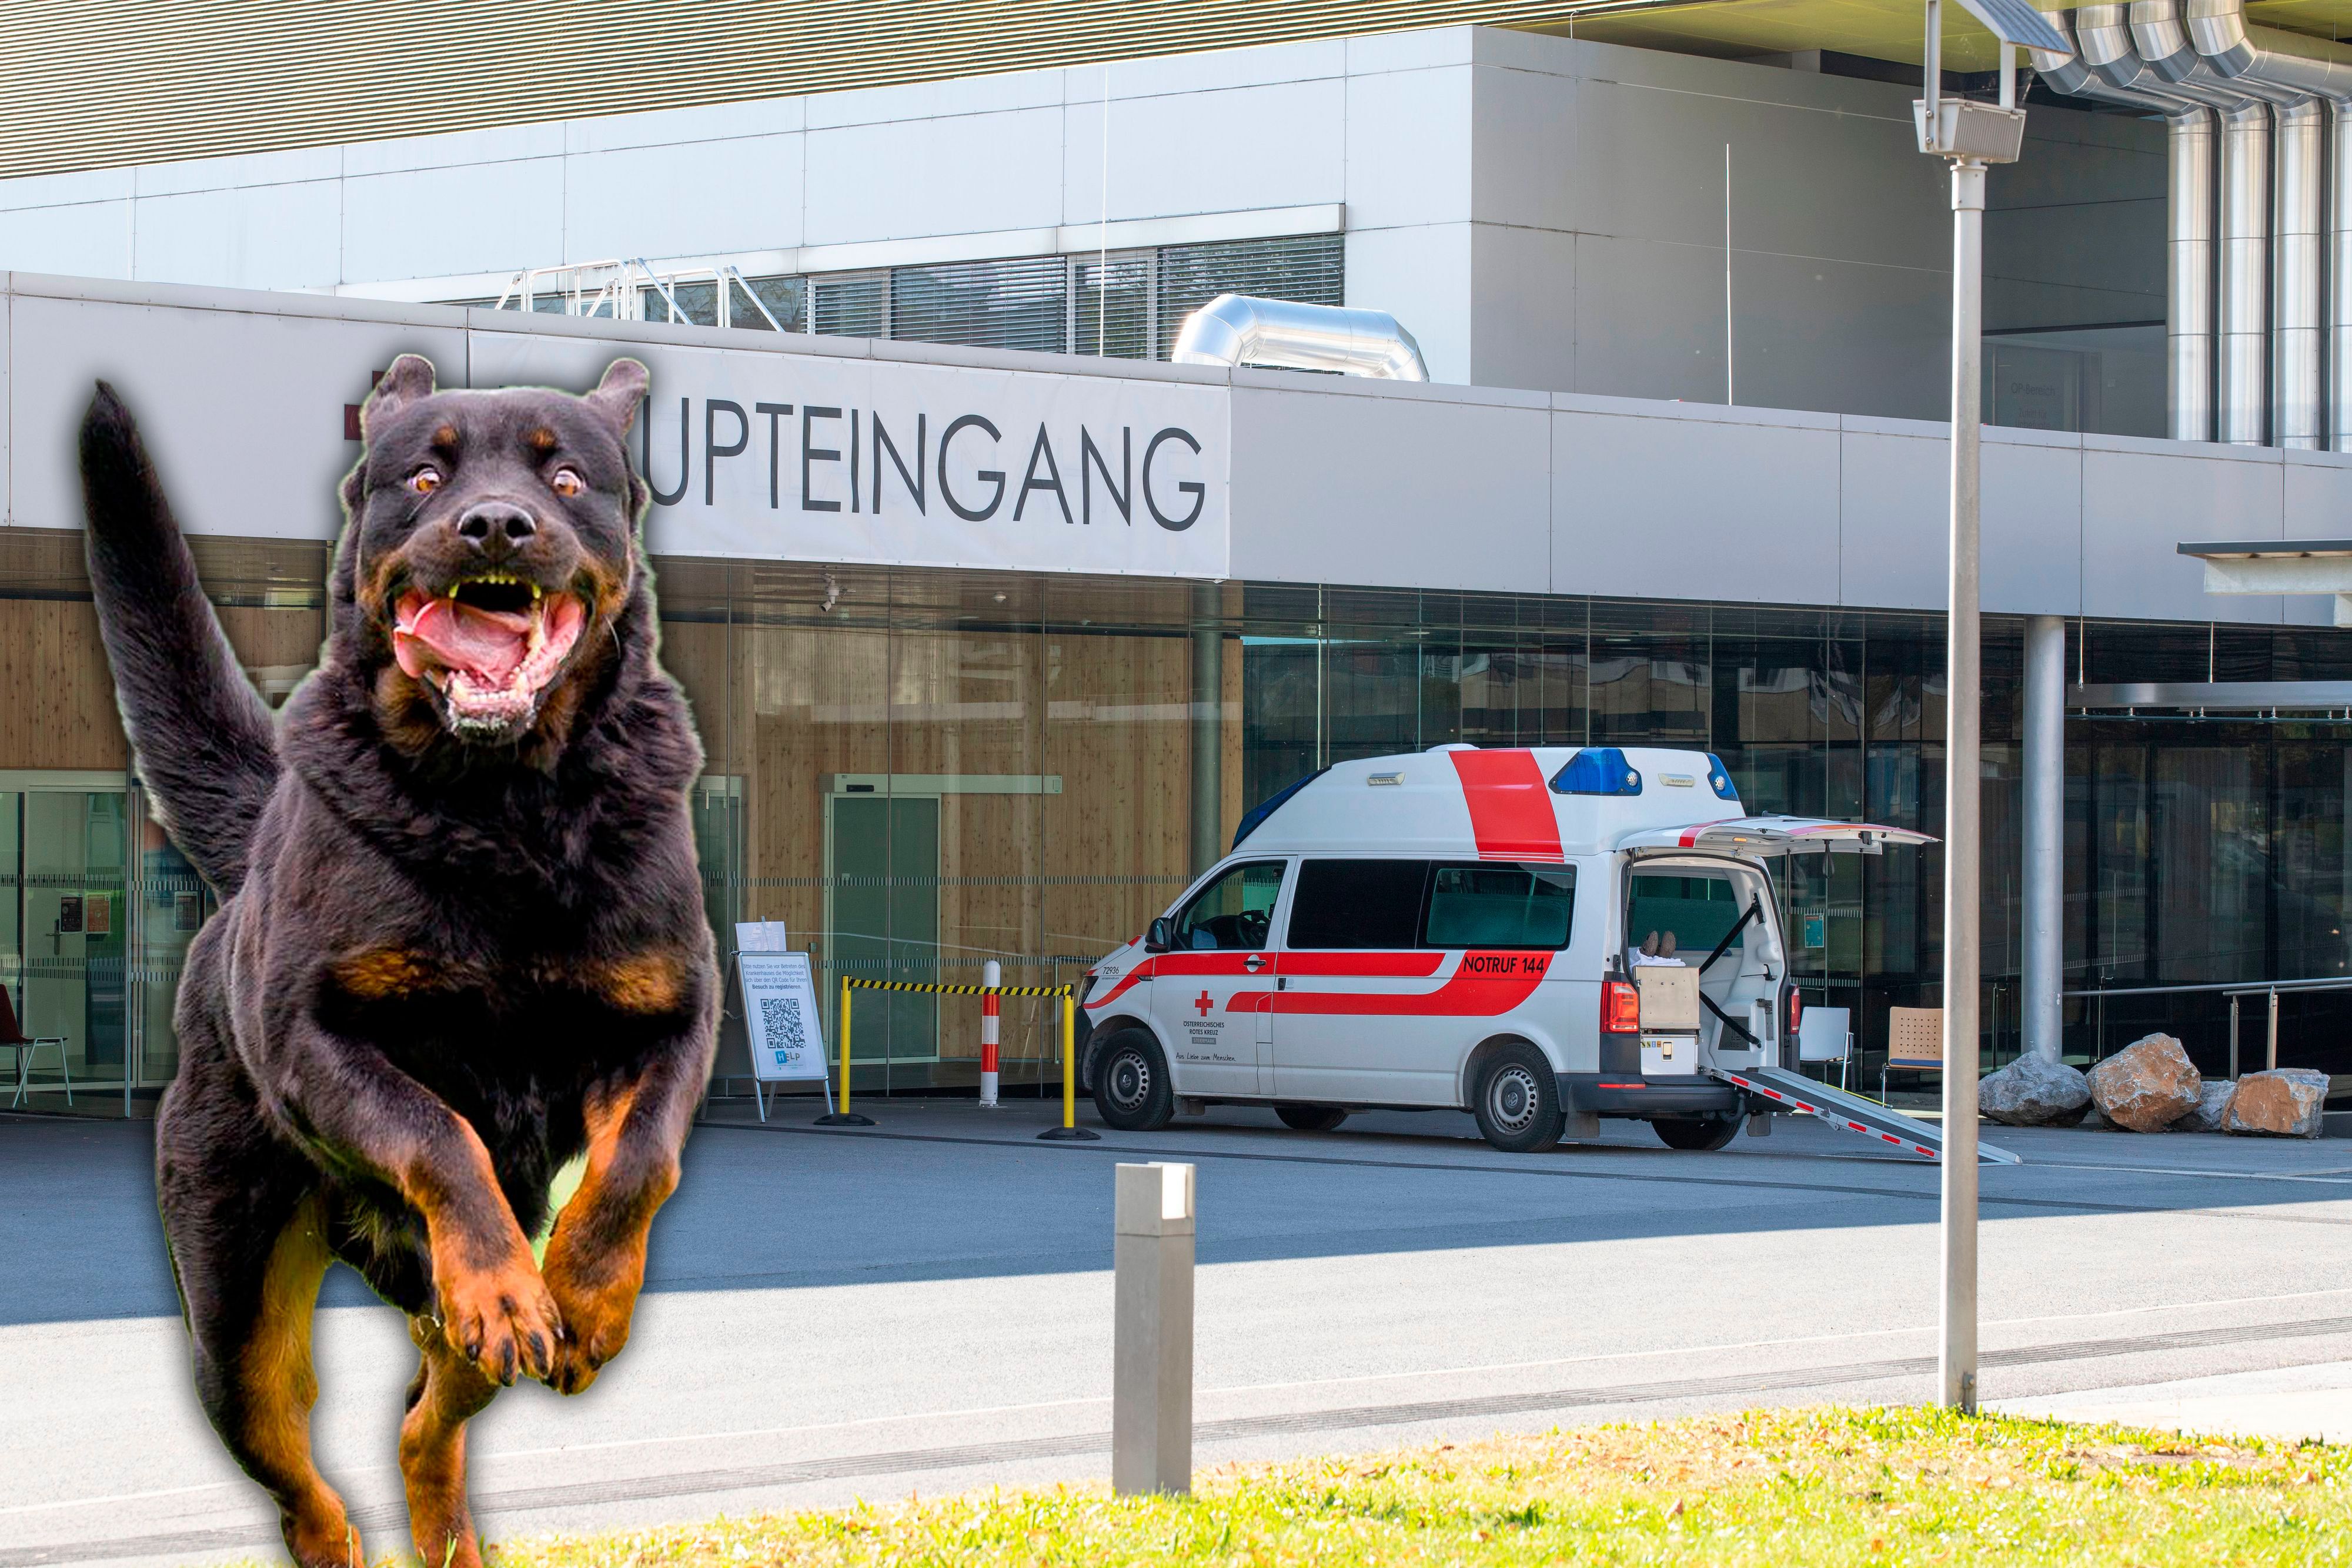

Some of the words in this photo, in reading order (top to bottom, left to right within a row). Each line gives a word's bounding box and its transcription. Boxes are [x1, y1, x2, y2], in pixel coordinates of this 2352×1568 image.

[643, 394, 1205, 531] UPTEINGANG
[1463, 956, 1517, 974] NOTRUF
[1523, 957, 1544, 974] 144
[1102, 966, 1120, 975] 72936
[1183, 1020, 1225, 1028] ÖSTERREICHISCHES
[1187, 1052, 1199, 1060] Liebe
[1213, 1053, 1237, 1062] Menschen.
